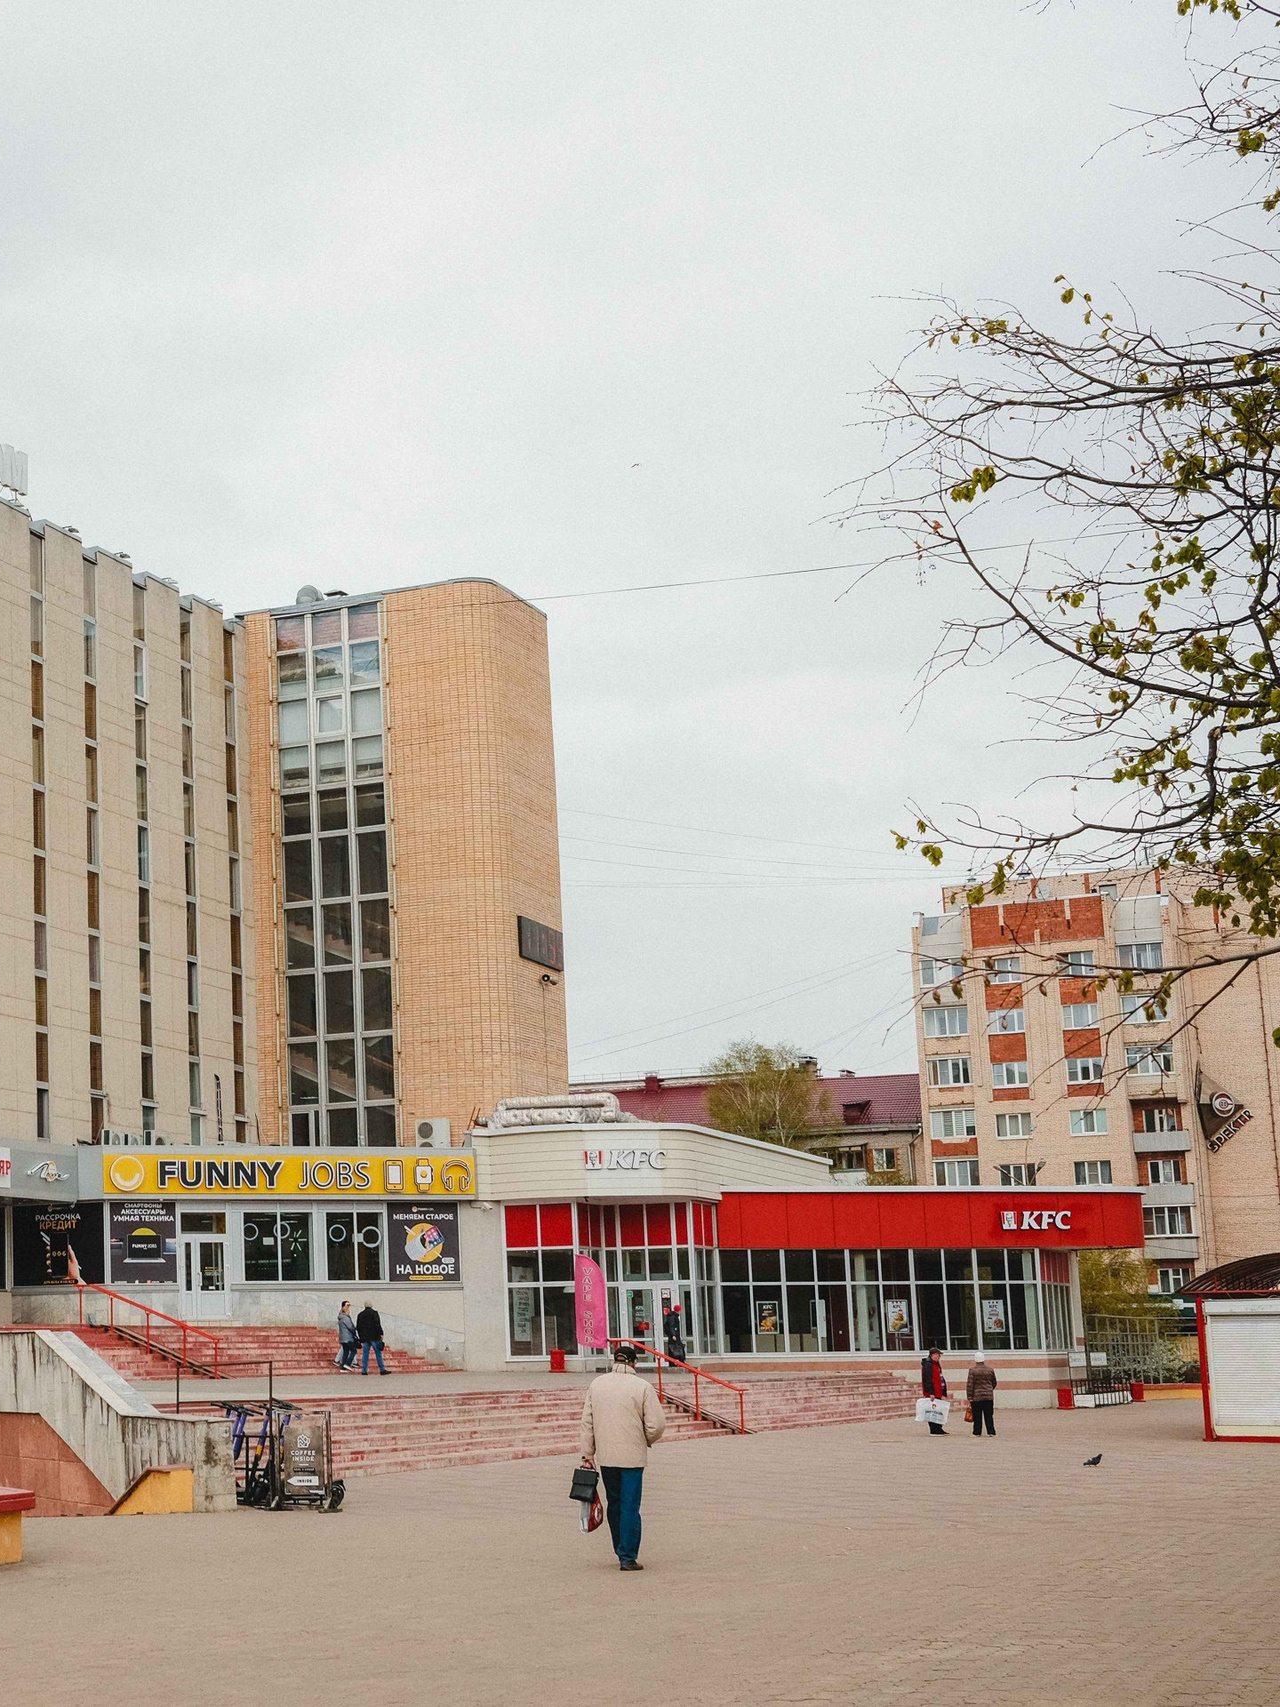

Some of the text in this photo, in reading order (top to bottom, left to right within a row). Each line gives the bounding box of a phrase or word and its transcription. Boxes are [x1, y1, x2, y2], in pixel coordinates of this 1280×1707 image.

[1207, 1108, 1254, 1153] SPEKTR
[607, 1149, 667, 1170] KFC
[157, 1159, 371, 1189] FUNNY JOBS
[35, 1213, 81, 1221] РАССРОЧКА
[39, 1220, 77, 1230] КРЕДИТ
[1020, 1210, 1072, 1230] KFC
[396, 1264, 455, 1274] НА НОВОЕ
[582, 1267, 593, 1302] VAPE
